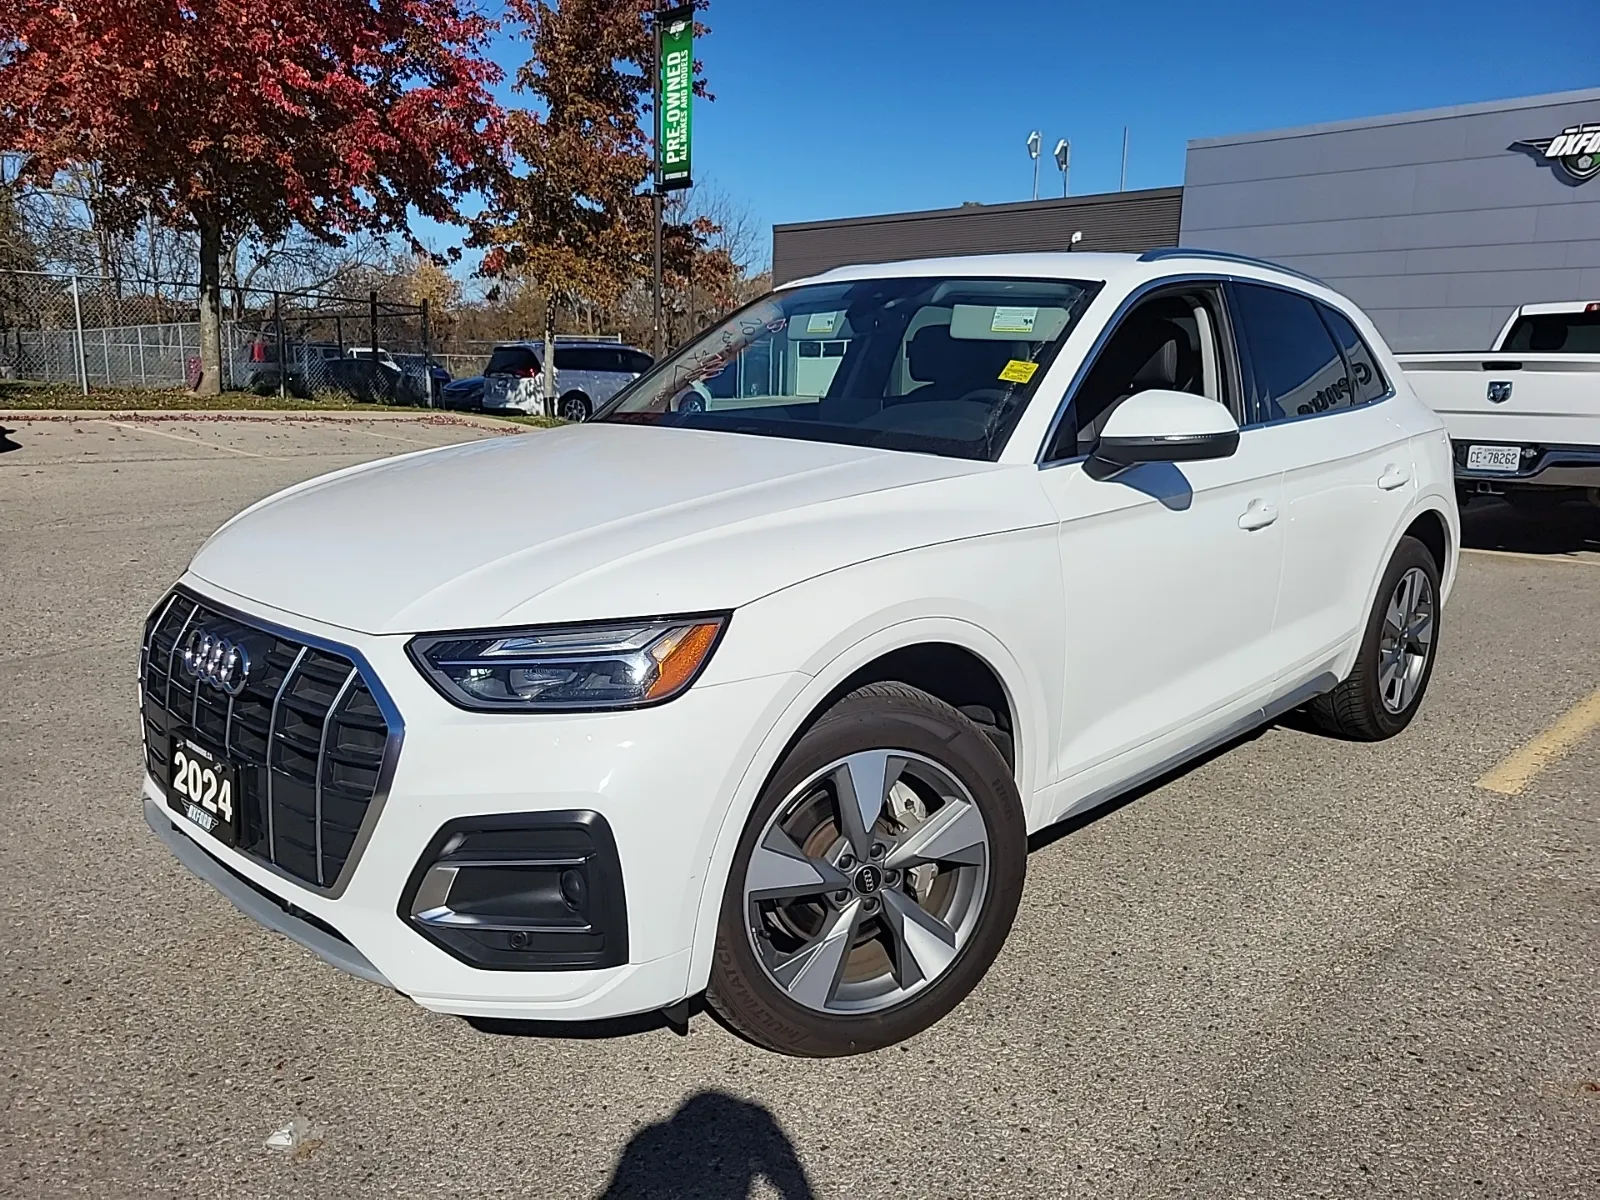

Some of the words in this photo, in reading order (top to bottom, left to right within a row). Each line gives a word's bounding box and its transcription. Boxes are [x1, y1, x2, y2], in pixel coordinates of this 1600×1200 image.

[666, 51, 681, 164] PRE-OWNED
[680, 90, 688, 108] AND
[680, 111, 688, 142] MAKES
[1545, 132, 1600, 157] OXFO
[1470, 451, 1482, 463] CE
[1488, 452, 1517, 464] 78262
[174, 751, 232, 822] 2024
